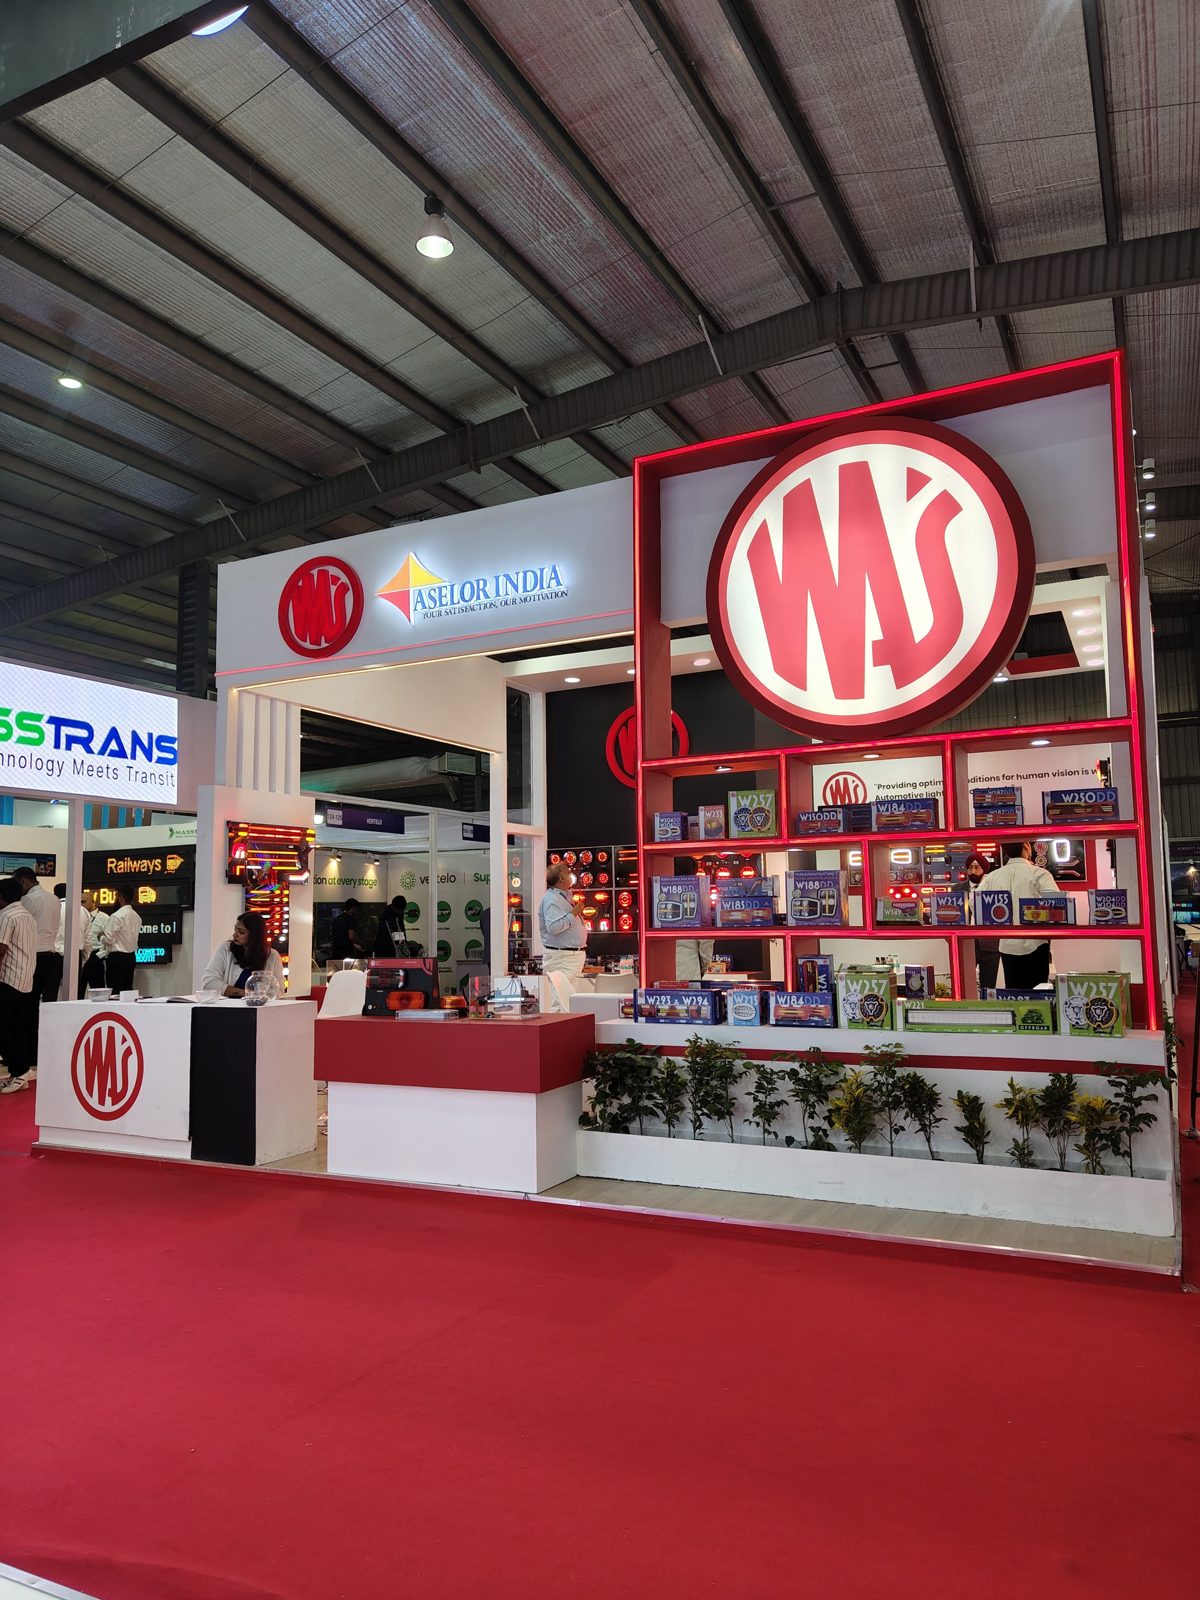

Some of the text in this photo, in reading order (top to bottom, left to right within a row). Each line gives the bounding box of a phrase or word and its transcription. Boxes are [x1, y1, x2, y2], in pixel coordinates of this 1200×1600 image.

[412, 564, 564, 612] ASELOR INDIA
[422, 590, 569, 619] YOUR SATISFACTION, OUR MOTIVATION
[72, 758, 119, 780] Meets
[126, 765, 175, 787] Transit
[1002, 773, 1015, 781] for
[1016, 771, 1050, 780] human
[1051, 769, 1080, 778] vision
[1081, 768, 1090, 776] is
[738, 793, 773, 807] W257
[875, 790, 925, 802] Automotive
[1061, 791, 1116, 803] W250DD
[878, 802, 922, 814] W184DD
[107, 856, 162, 874] Railways
[328, 876, 336, 885] at
[336, 877, 357, 888] every
[357, 877, 378, 889] stage
[419, 872, 456, 885] vetelo
[937, 896, 963, 906] W214
[982, 893, 1009, 904] W155
[160, 922, 172, 934] to
[846, 979, 888, 995] W257
[1069, 981, 1119, 999] W257
[646, 995, 670, 1005] W293
[682, 995, 708, 1006] W294
[777, 994, 820, 1006] W184DD
